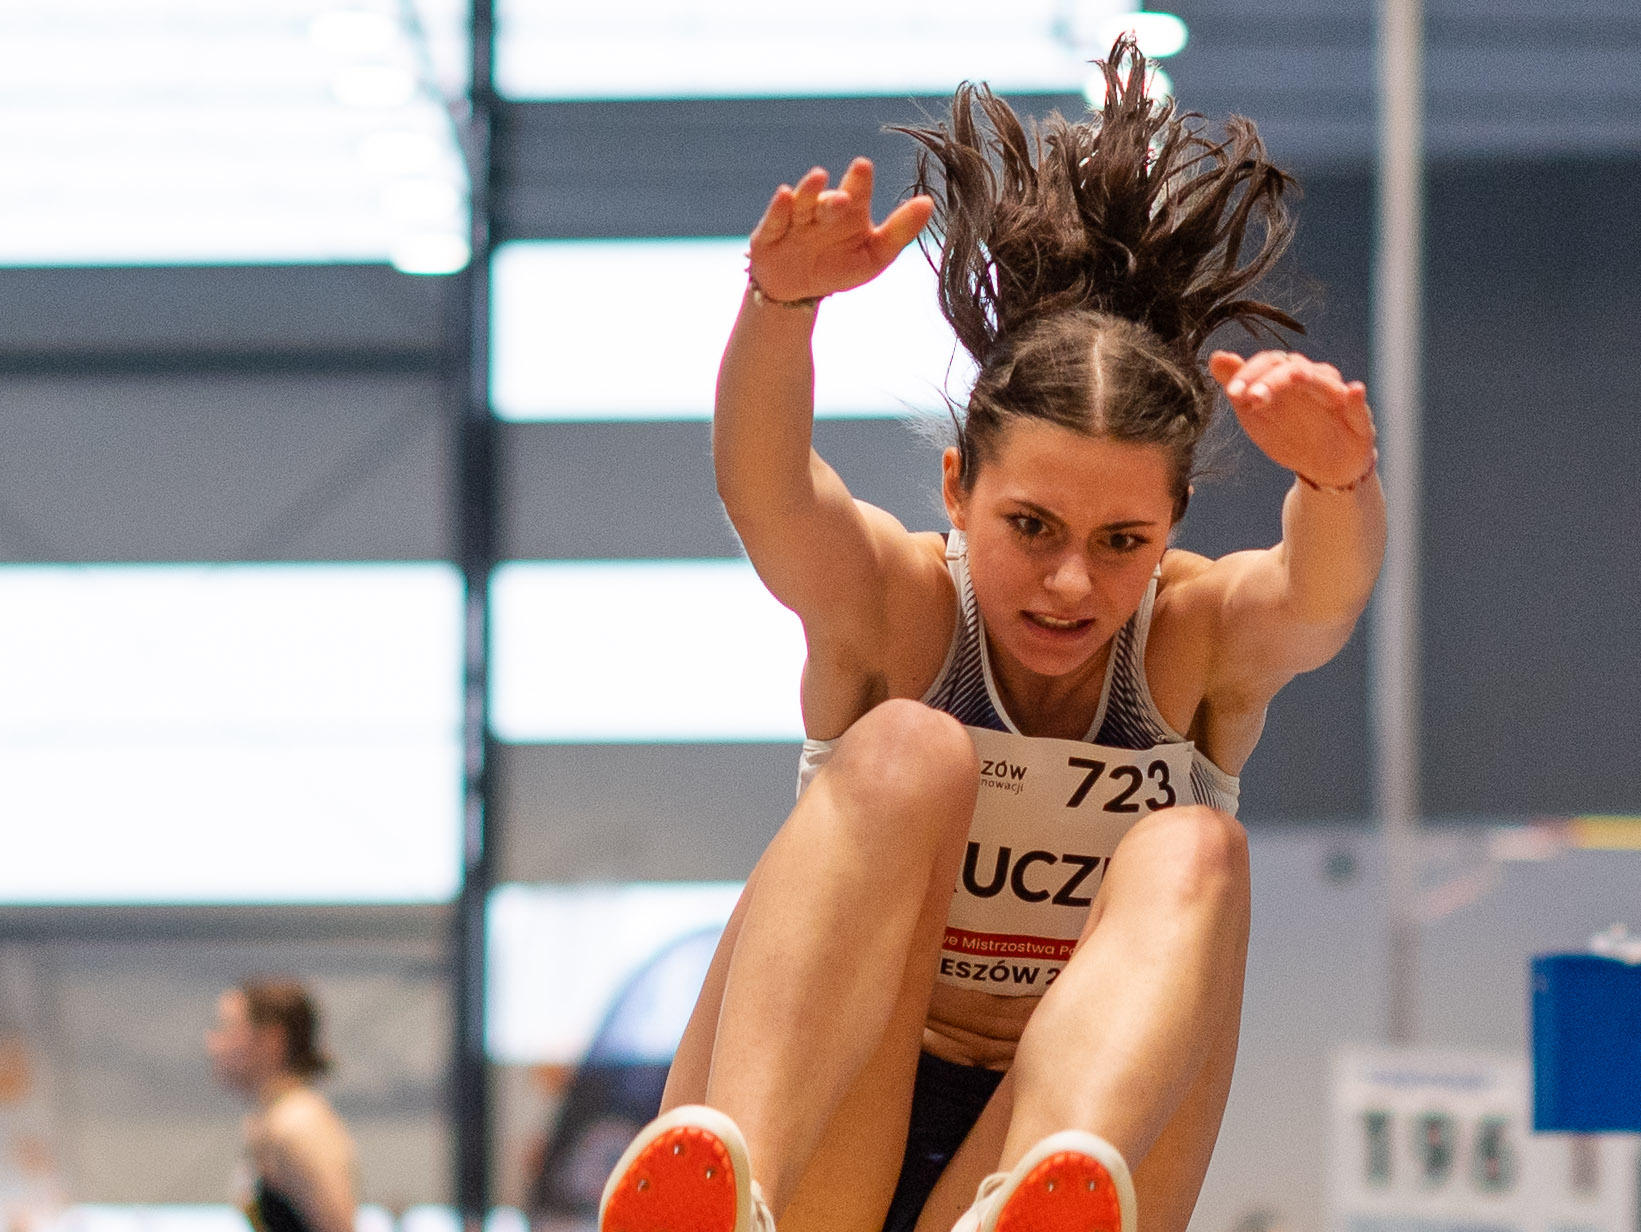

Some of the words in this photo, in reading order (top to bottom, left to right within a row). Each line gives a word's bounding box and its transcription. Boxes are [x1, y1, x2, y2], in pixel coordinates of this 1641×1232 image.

[981, 760, 1027, 781] ZÓW
[981, 778, 1024, 795] nowacji
[1066, 757, 1176, 812] 723
[953, 841, 1111, 907] UCZ
[962, 936, 1055, 955] Mistrzostwa
[940, 957, 1041, 985] ESZÓW
